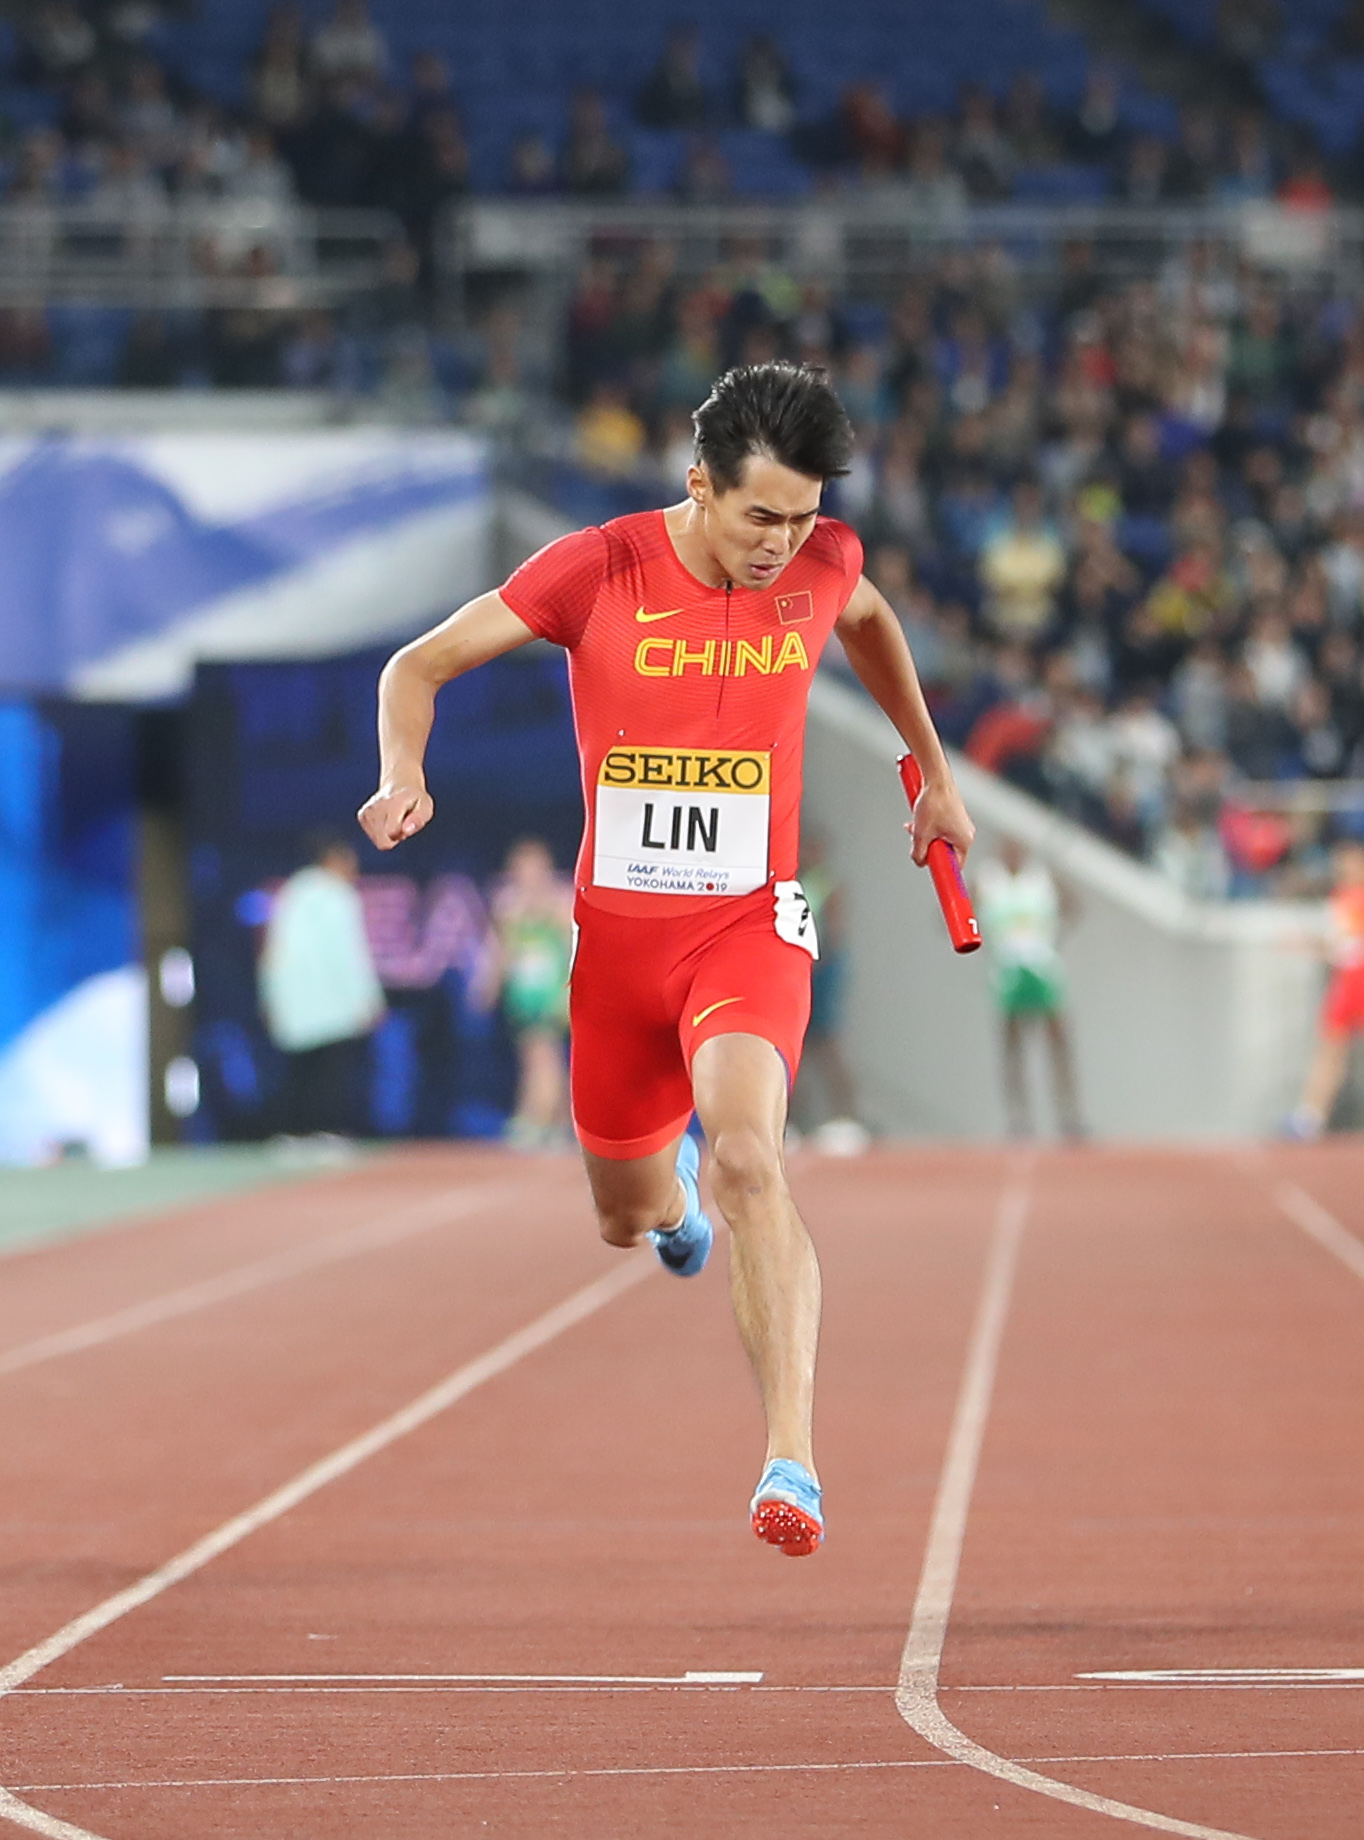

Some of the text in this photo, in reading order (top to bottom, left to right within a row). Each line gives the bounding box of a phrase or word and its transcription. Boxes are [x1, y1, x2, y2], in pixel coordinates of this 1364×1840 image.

[633, 631, 809, 677] CHINA
[604, 752, 763, 790] SEIKO
[640, 802, 720, 853] LIN
[626, 876, 695, 891] YOKOHAMA
[627, 863, 730, 880] IAAF World Relays
